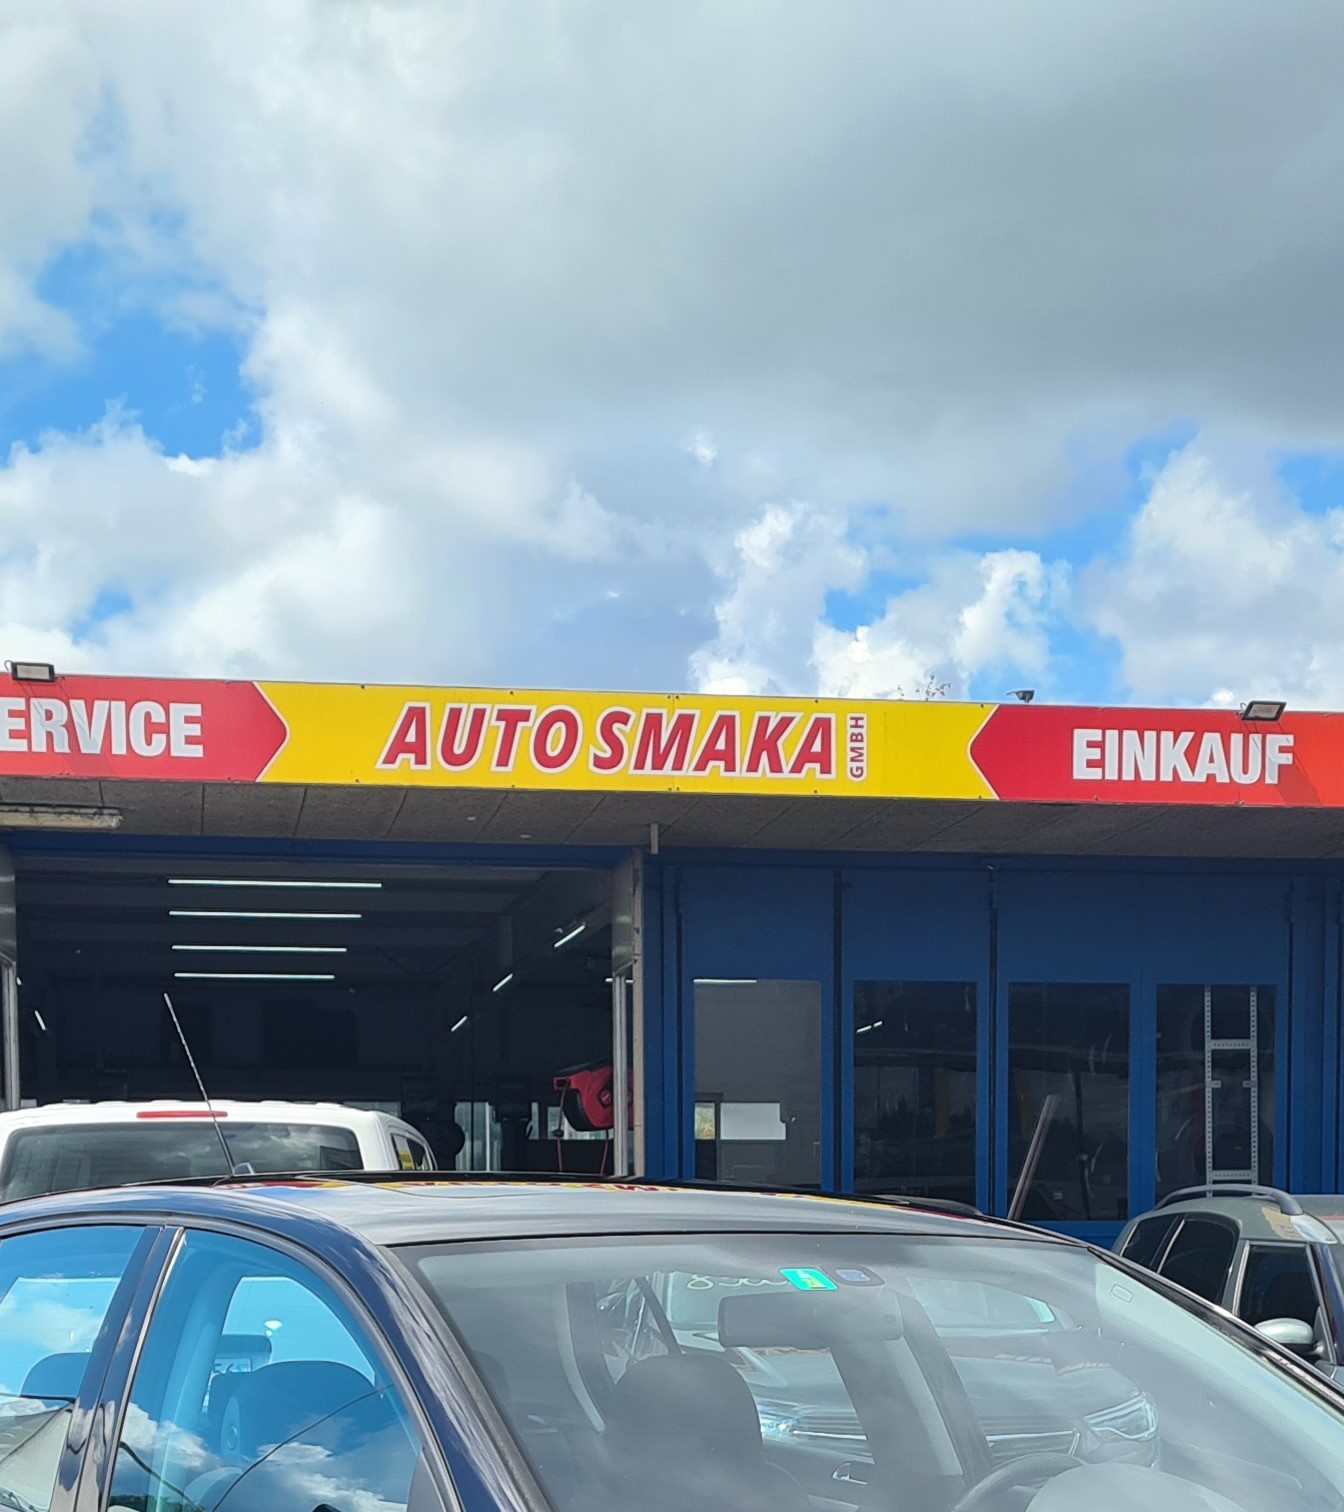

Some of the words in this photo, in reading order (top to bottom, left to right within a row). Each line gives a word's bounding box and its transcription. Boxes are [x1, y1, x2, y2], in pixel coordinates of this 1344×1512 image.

[377, 702, 583, 772] AUTO
[590, 709, 836, 778] SMAKA
[849, 715, 865, 779] GMBH
[1072, 728, 1294, 785] EINKAUF
